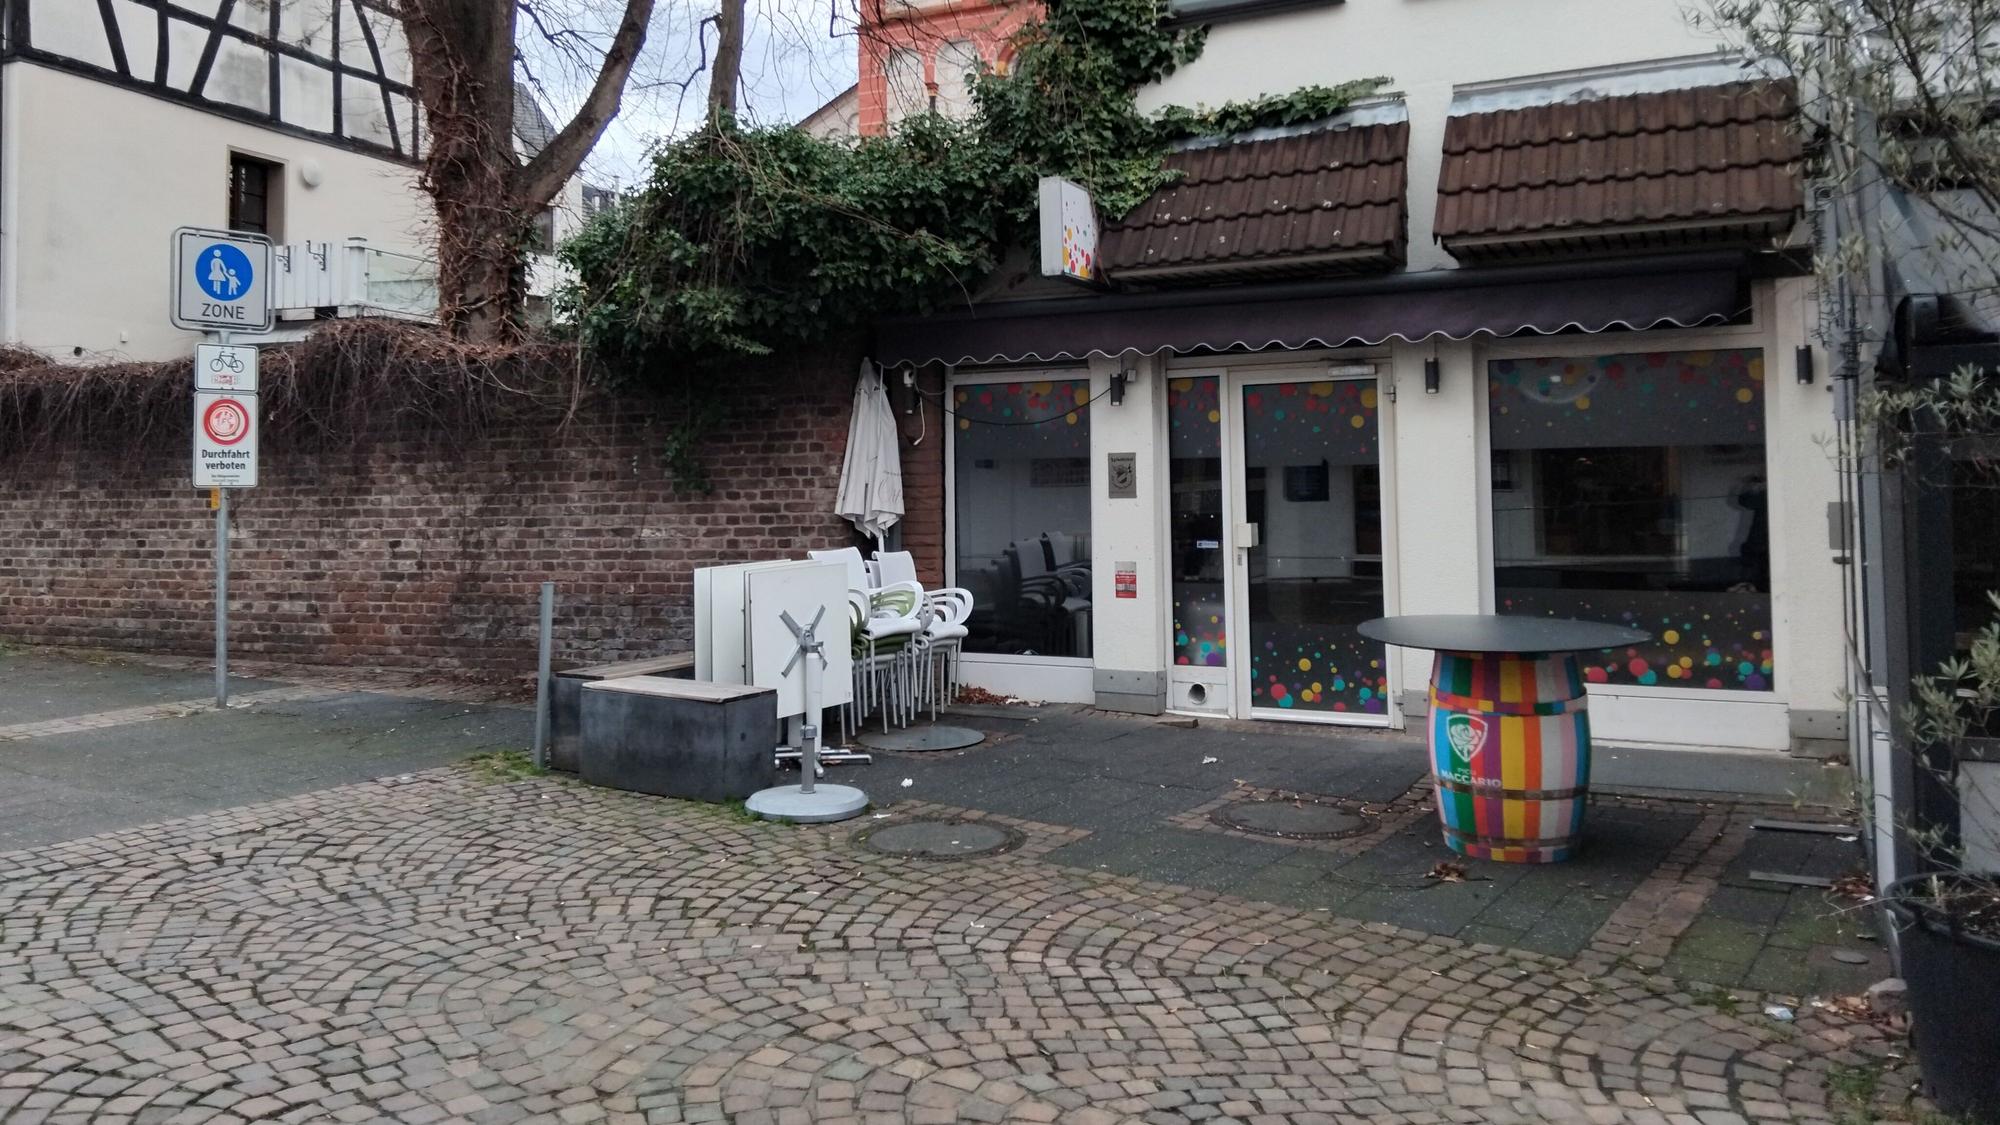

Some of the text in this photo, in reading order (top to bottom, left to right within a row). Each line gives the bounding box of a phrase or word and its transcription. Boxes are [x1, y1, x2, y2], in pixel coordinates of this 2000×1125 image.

[201, 302, 245, 320] ZONE
[201, 449, 250, 459] Durchfahrt
[205, 461, 246, 470] verboten
[1440, 769, 1502, 788] MACCARIO
